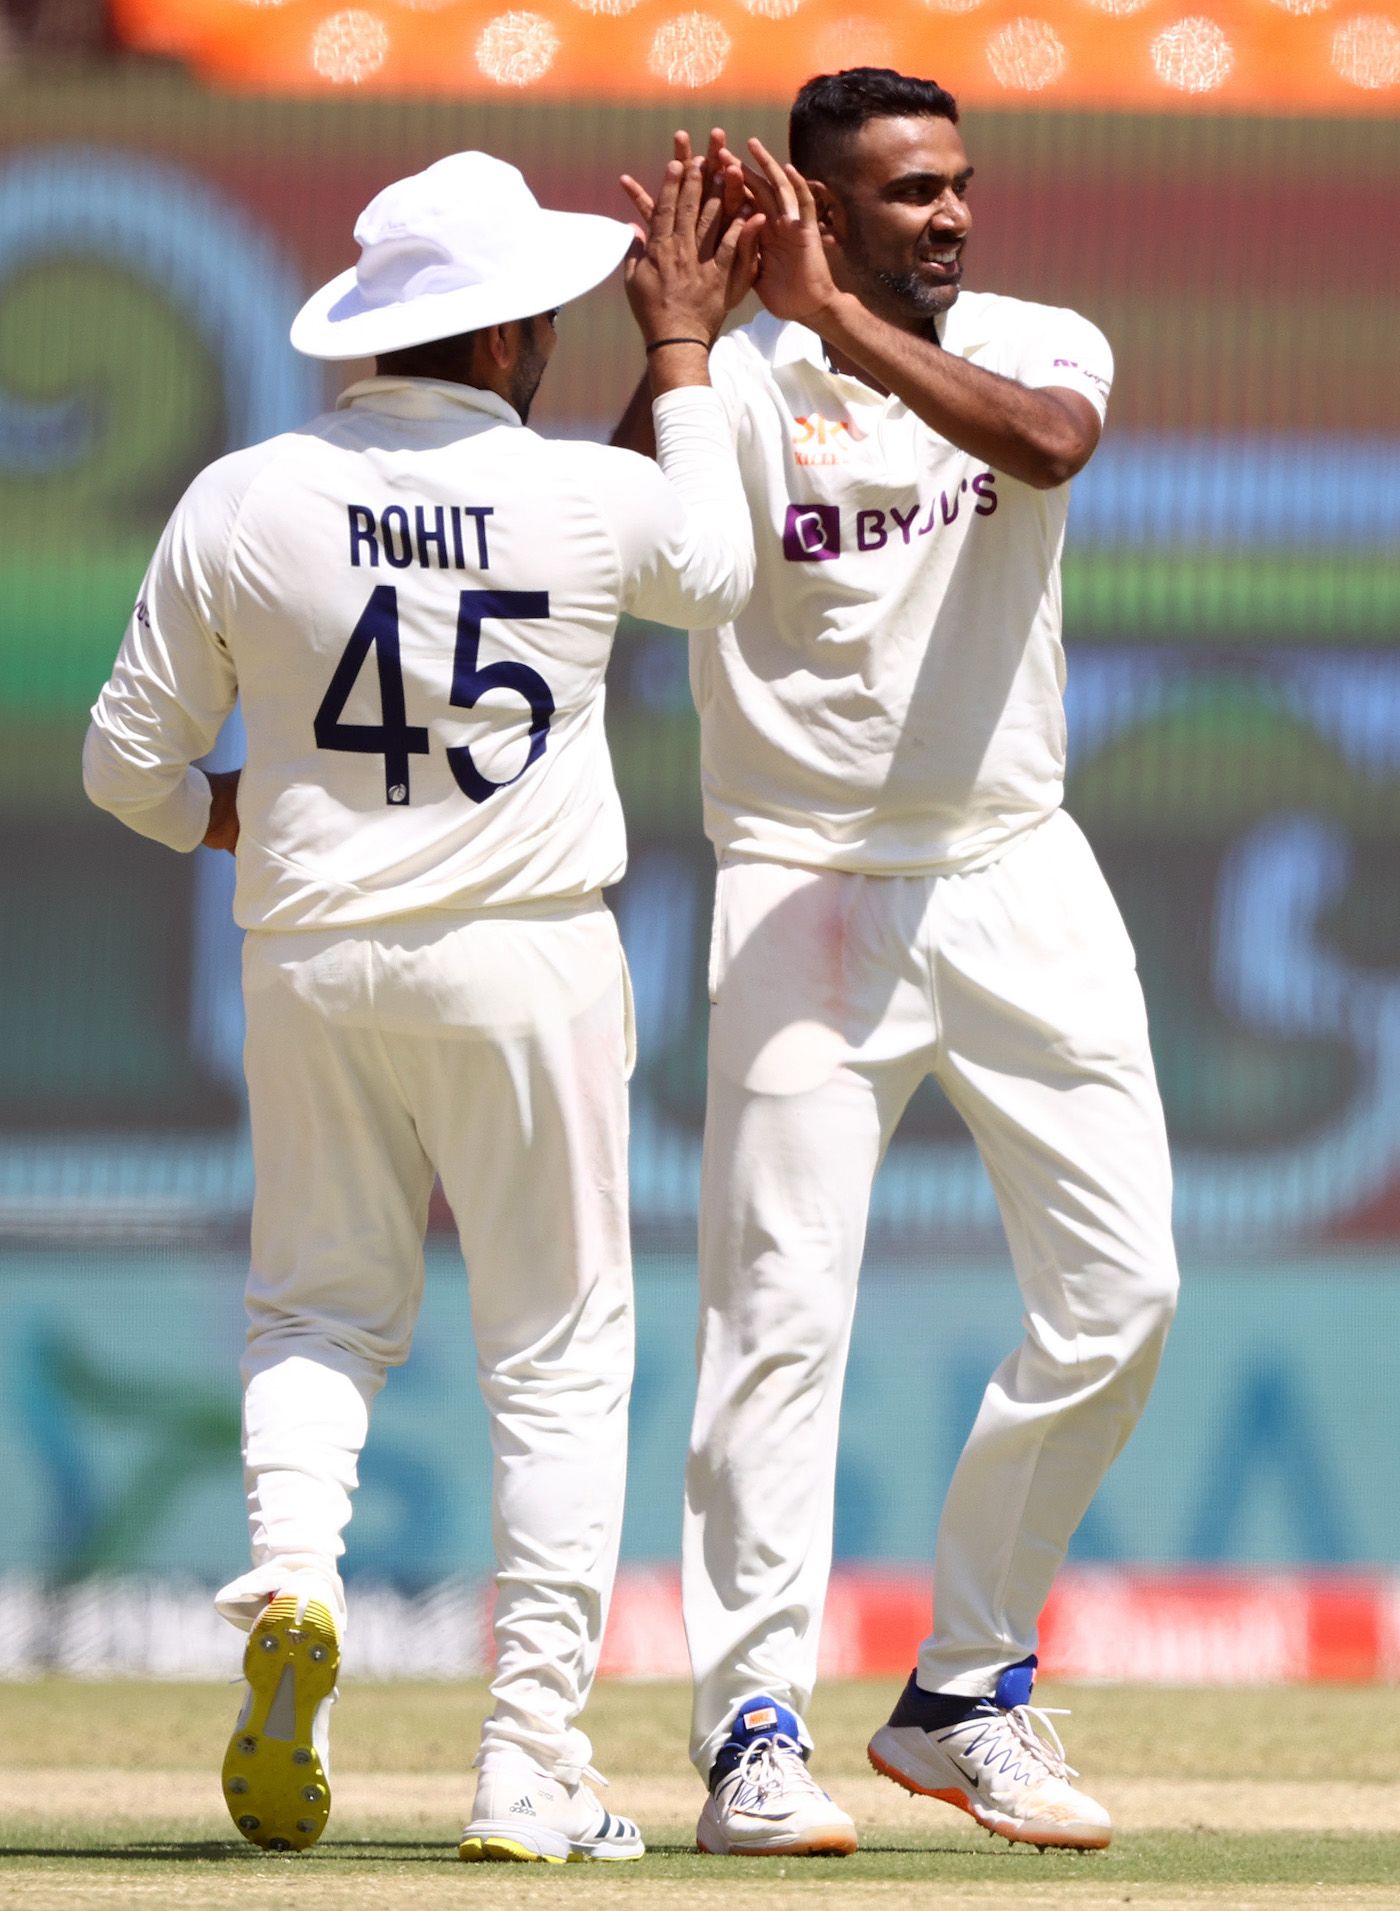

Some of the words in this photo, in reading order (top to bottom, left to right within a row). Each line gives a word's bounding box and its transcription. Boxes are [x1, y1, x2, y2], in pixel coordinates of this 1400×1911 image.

[347, 504, 494, 570] ROHIT
[794, 512, 828, 553] B
[856, 473, 998, 551] BYJU'S
[313, 585, 556, 806] 45
